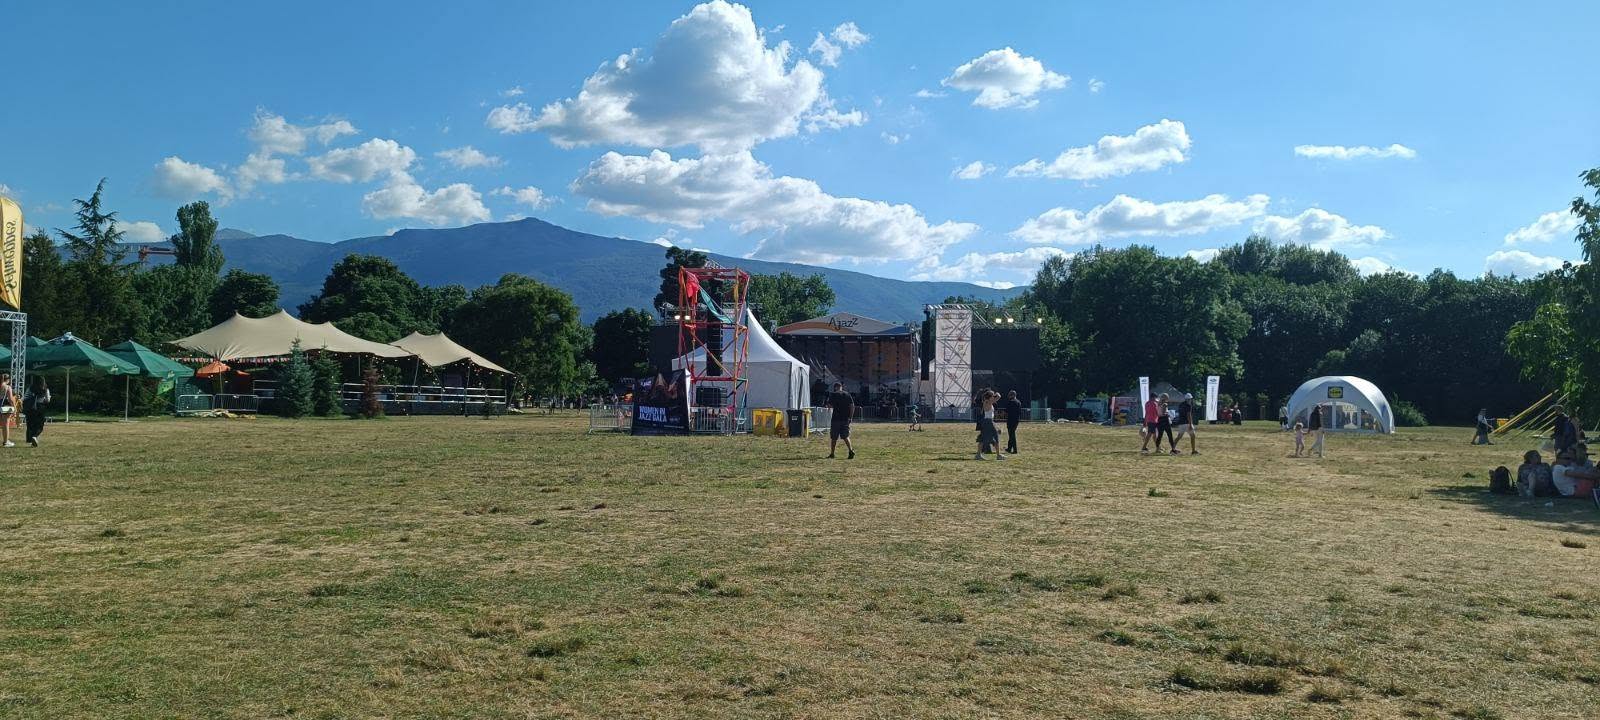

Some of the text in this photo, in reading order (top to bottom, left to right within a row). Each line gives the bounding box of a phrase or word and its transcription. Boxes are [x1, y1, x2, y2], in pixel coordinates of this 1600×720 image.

[639, 406, 666, 416] WOMEN IN
[652, 413, 667, 422] GALA
